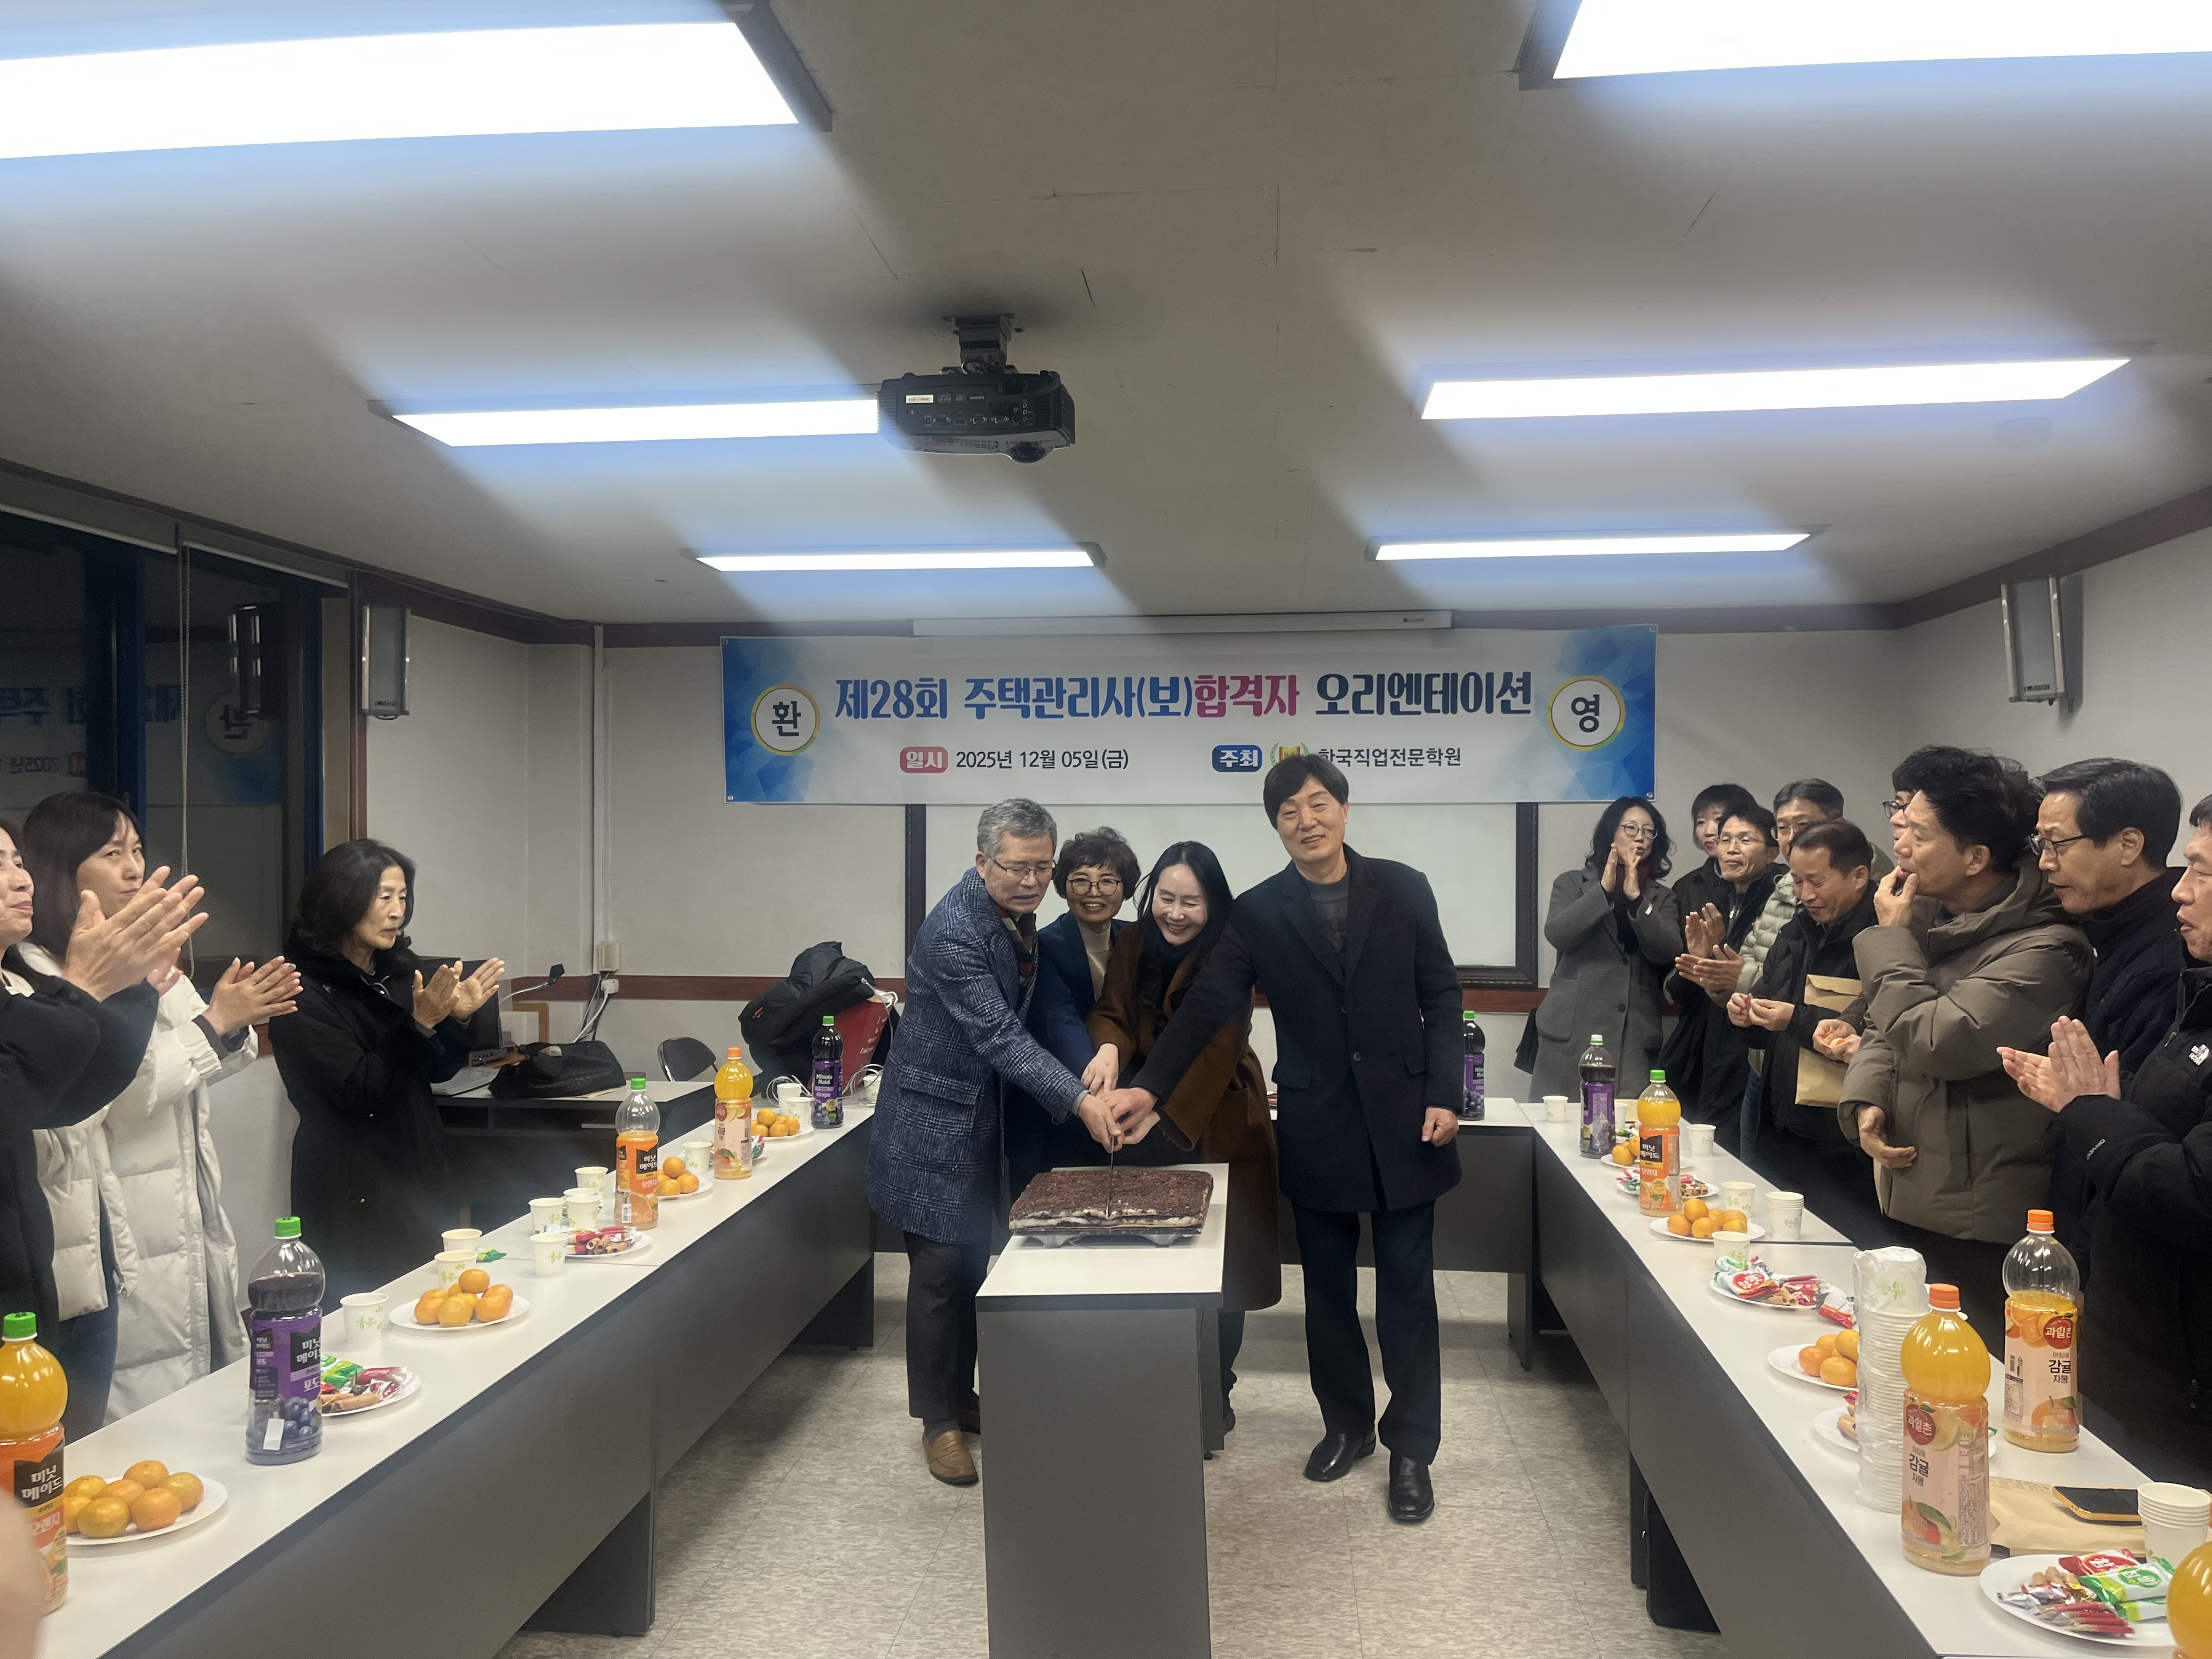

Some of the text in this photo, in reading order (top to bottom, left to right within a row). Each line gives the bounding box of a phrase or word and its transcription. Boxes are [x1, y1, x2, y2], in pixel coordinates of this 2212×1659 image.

[835, 672, 1531, 720] 제28회 주택관리사(보)합격자 오리엔테이션
[772, 701, 801, 736] 환
[1571, 694, 1600, 733] 영
[906, 749, 1128, 769] 일시 2025년 12월 05일(금)
[1220, 748, 1460, 768] 주최 한국직업전문학원
[1642, 1144, 1655, 1152] 미닛
[640, 1161, 658, 1170] 메이드
[2045, 1326, 2072, 1339] 과일촌
[302, 1337, 321, 1350] 미닛
[2049, 1359, 2071, 1374] 감귤
[303, 1376, 320, 1392] 포도
[2053, 1375, 2068, 1384] 자몽
[1908, 1414, 1933, 1436] 과일촌
[31, 1465, 57, 1483] 미닛
[1909, 1453, 1929, 1478] 감귤
[21, 1476, 63, 1500] 메이드
[1912, 1472, 1924, 1487] 자몽
